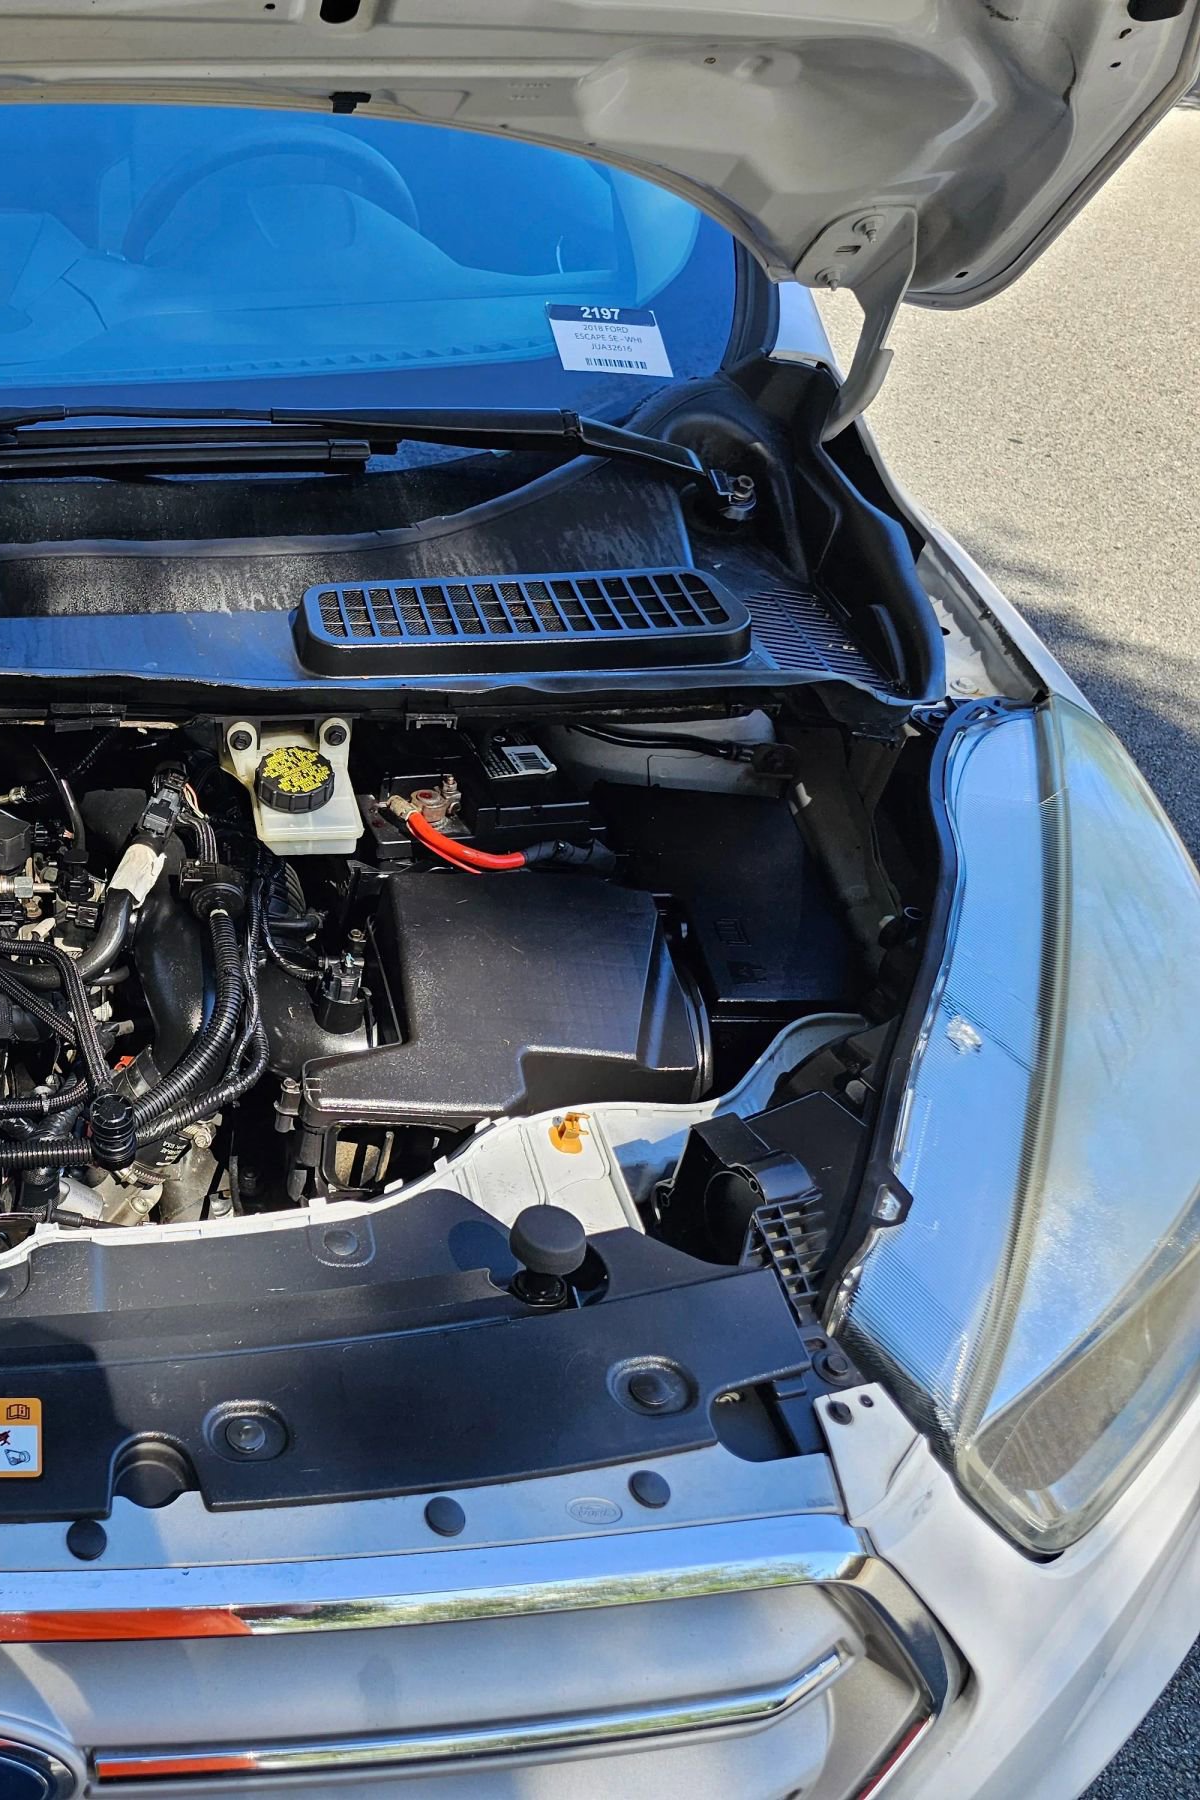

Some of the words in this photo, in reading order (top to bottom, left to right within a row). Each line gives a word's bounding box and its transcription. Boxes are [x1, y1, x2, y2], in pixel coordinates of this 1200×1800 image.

[580, 306, 620, 320] 2197
[583, 324, 603, 332] 2018
[605, 325, 629, 333] FORD
[574, 333, 606, 341] ESCAPE
[609, 334, 617, 342] SE
